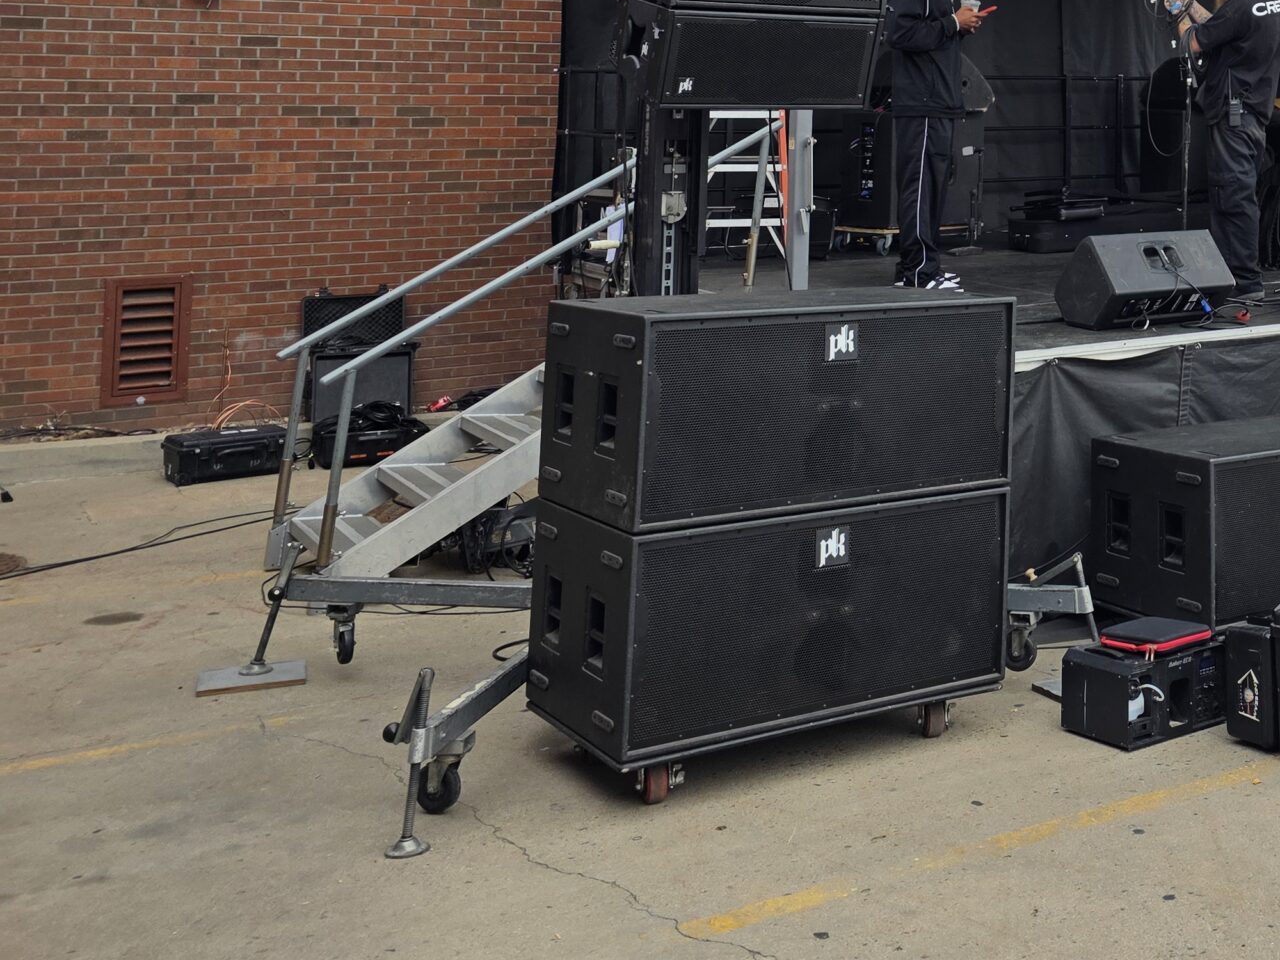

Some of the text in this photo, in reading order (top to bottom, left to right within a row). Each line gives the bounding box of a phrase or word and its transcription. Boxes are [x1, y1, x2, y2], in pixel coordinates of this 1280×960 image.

[678, 77, 693, 94] pk
[829, 324, 855, 361] pk
[819, 528, 846, 567] pk
